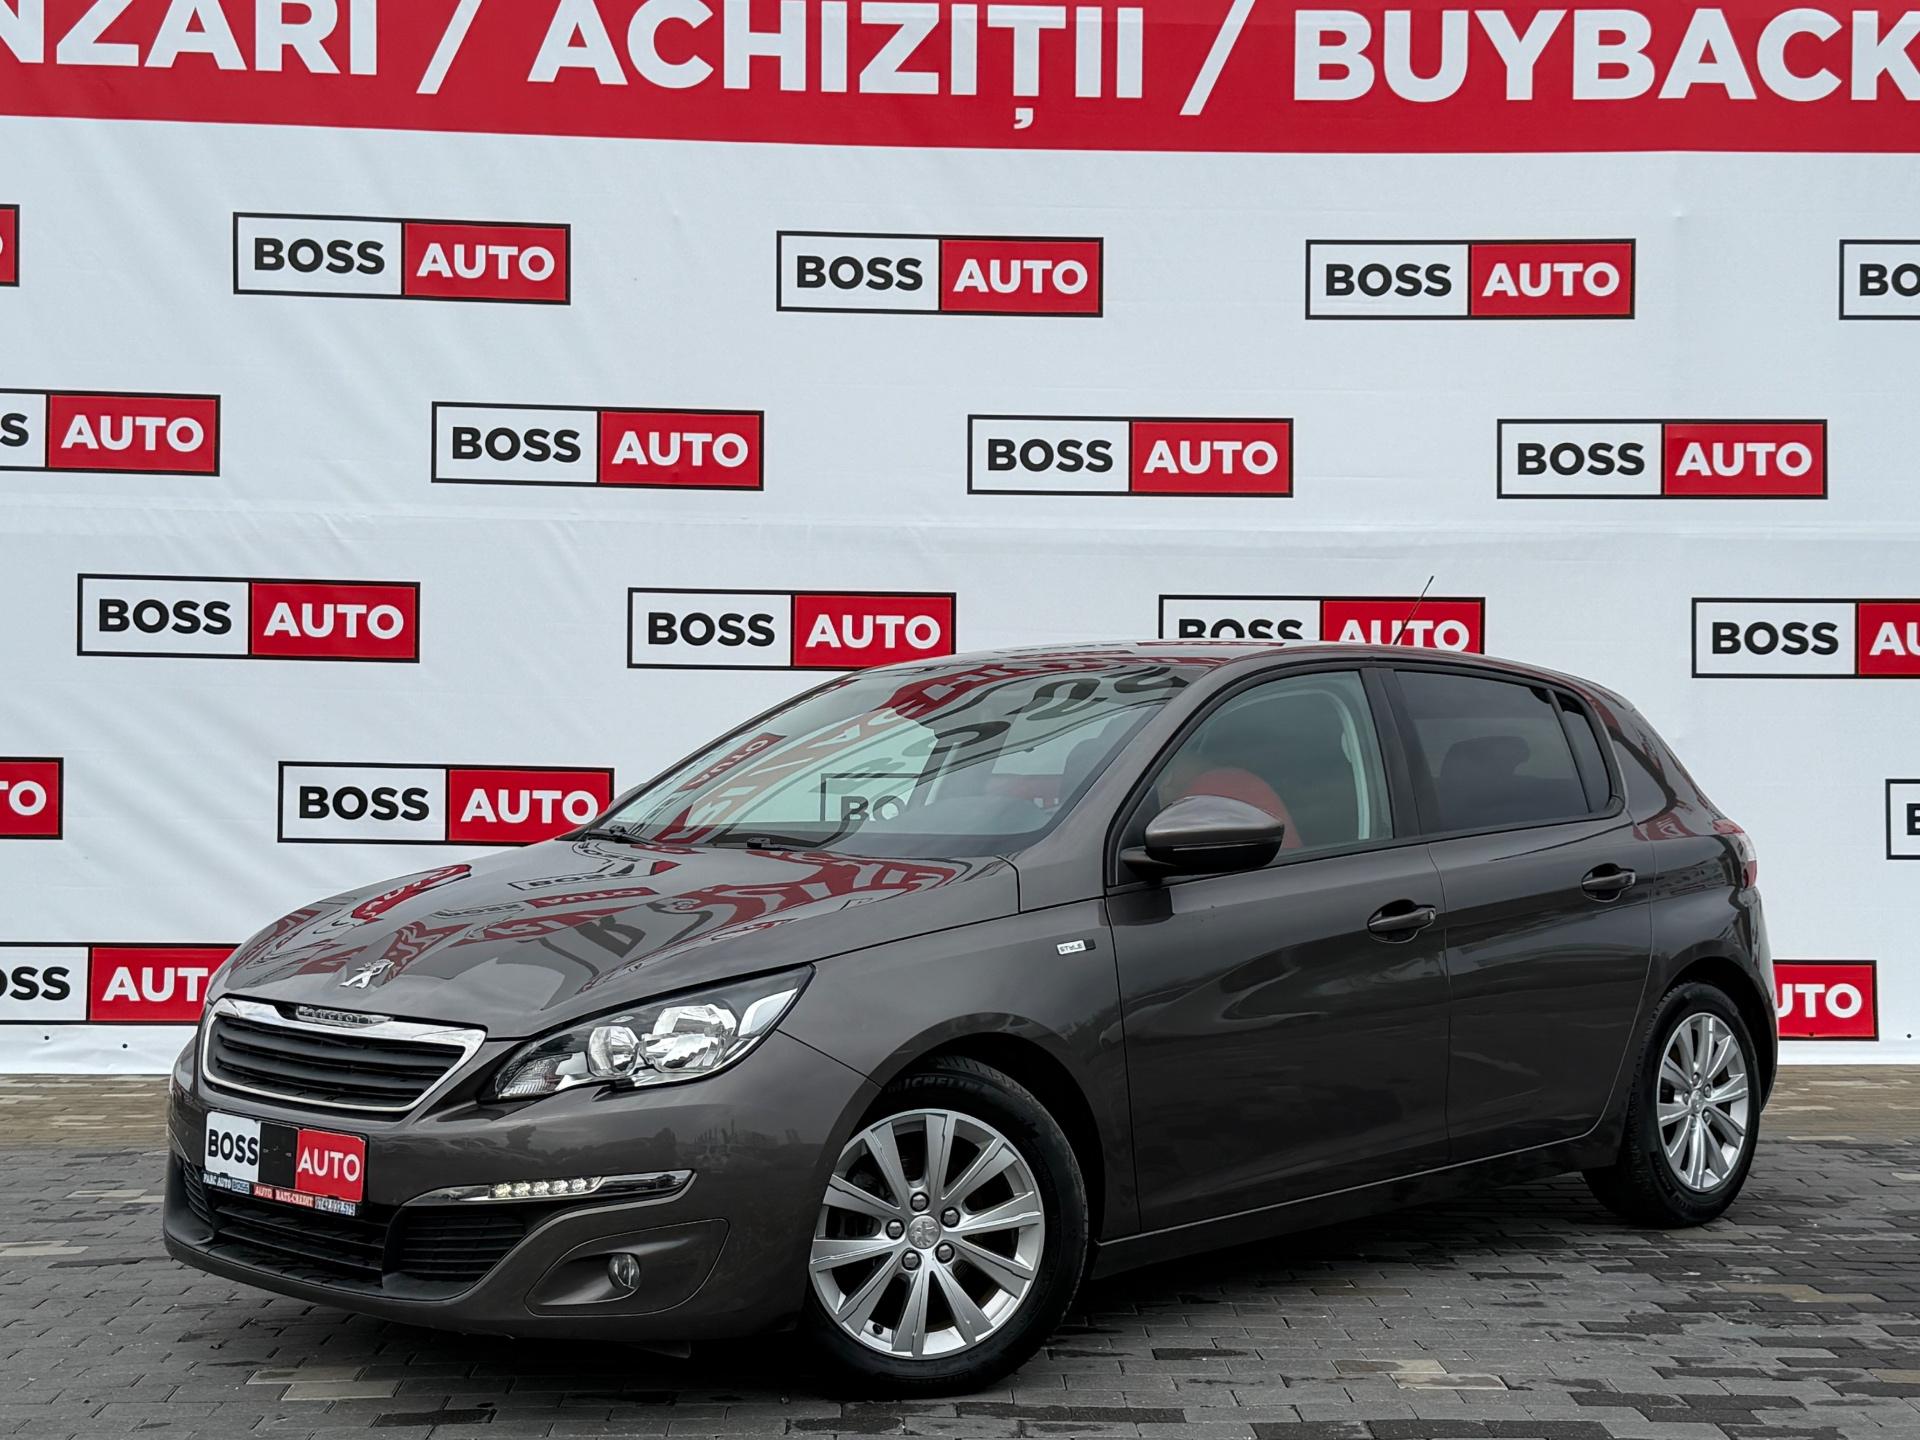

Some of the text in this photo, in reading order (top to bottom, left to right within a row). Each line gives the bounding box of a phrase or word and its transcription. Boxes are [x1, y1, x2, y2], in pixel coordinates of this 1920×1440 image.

[1294, 9, 1920, 102] BUYBACK
[254, 237, 555, 281] BOSS AUTO
[796, 255, 1088, 295] BOSS AUTO
[1325, 261, 1620, 298] BOSS AUTO
[60, 414, 204, 452] AUTO
[452, 426, 749, 468] BOSS AUTO
[987, 438, 1279, 475] BOSS AUTO
[1517, 442, 1813, 477] BOSS AUTO
[98, 598, 404, 640] BOSS AUTO
[648, 611, 942, 650] BOSS AUTO
[1338, 619, 1470, 652] AUTO
[1712, 621, 1839, 656] BOSS
[299, 785, 599, 826] BOSS AUTO
[102, 966, 210, 1002] AUT
[207, 1129, 361, 1182] BOSS AUTO
